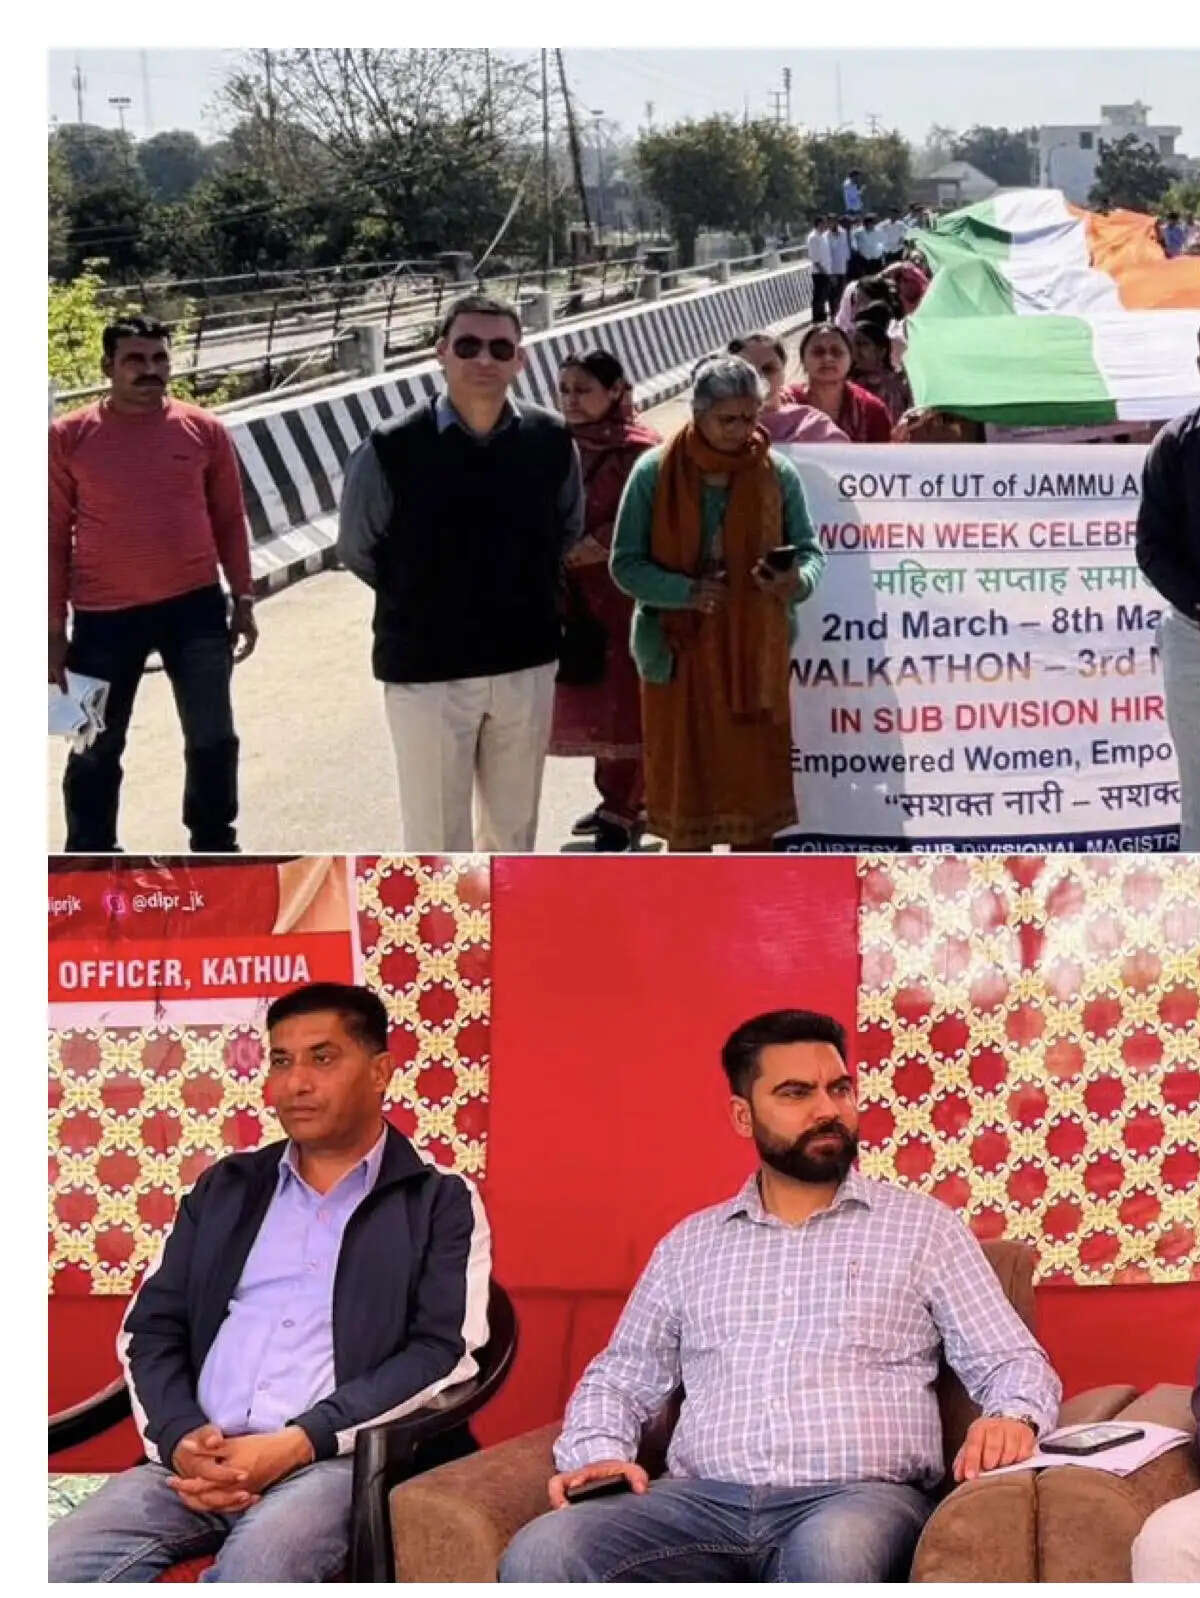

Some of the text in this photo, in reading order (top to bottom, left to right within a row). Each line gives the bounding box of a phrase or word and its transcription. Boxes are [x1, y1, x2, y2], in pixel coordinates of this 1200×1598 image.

[838, 474, 911, 497] GOVT
[920, 474, 945, 497] of
[952, 475, 985, 497] UT
[993, 473, 1018, 497] of
[1024, 474, 1114, 497] JAMMU
[935, 521, 1019, 549] WEEK
[872, 558, 968, 599] महिला
[975, 566, 1070, 595] सप्ताह
[822, 612, 888, 642] 2nd
[902, 607, 1009, 639] March
[1052, 605, 1105, 634] 8th
[1078, 647, 1135, 678] 3rd
[831, 708, 862, 734] IN
[873, 704, 944, 734] SUB
[955, 698, 1100, 730] DIVISION
[963, 746, 1081, 776] Women,
[1002, 780, 1064, 816] नारी
[58, 954, 312, 991] OFFICER, KATHUA
